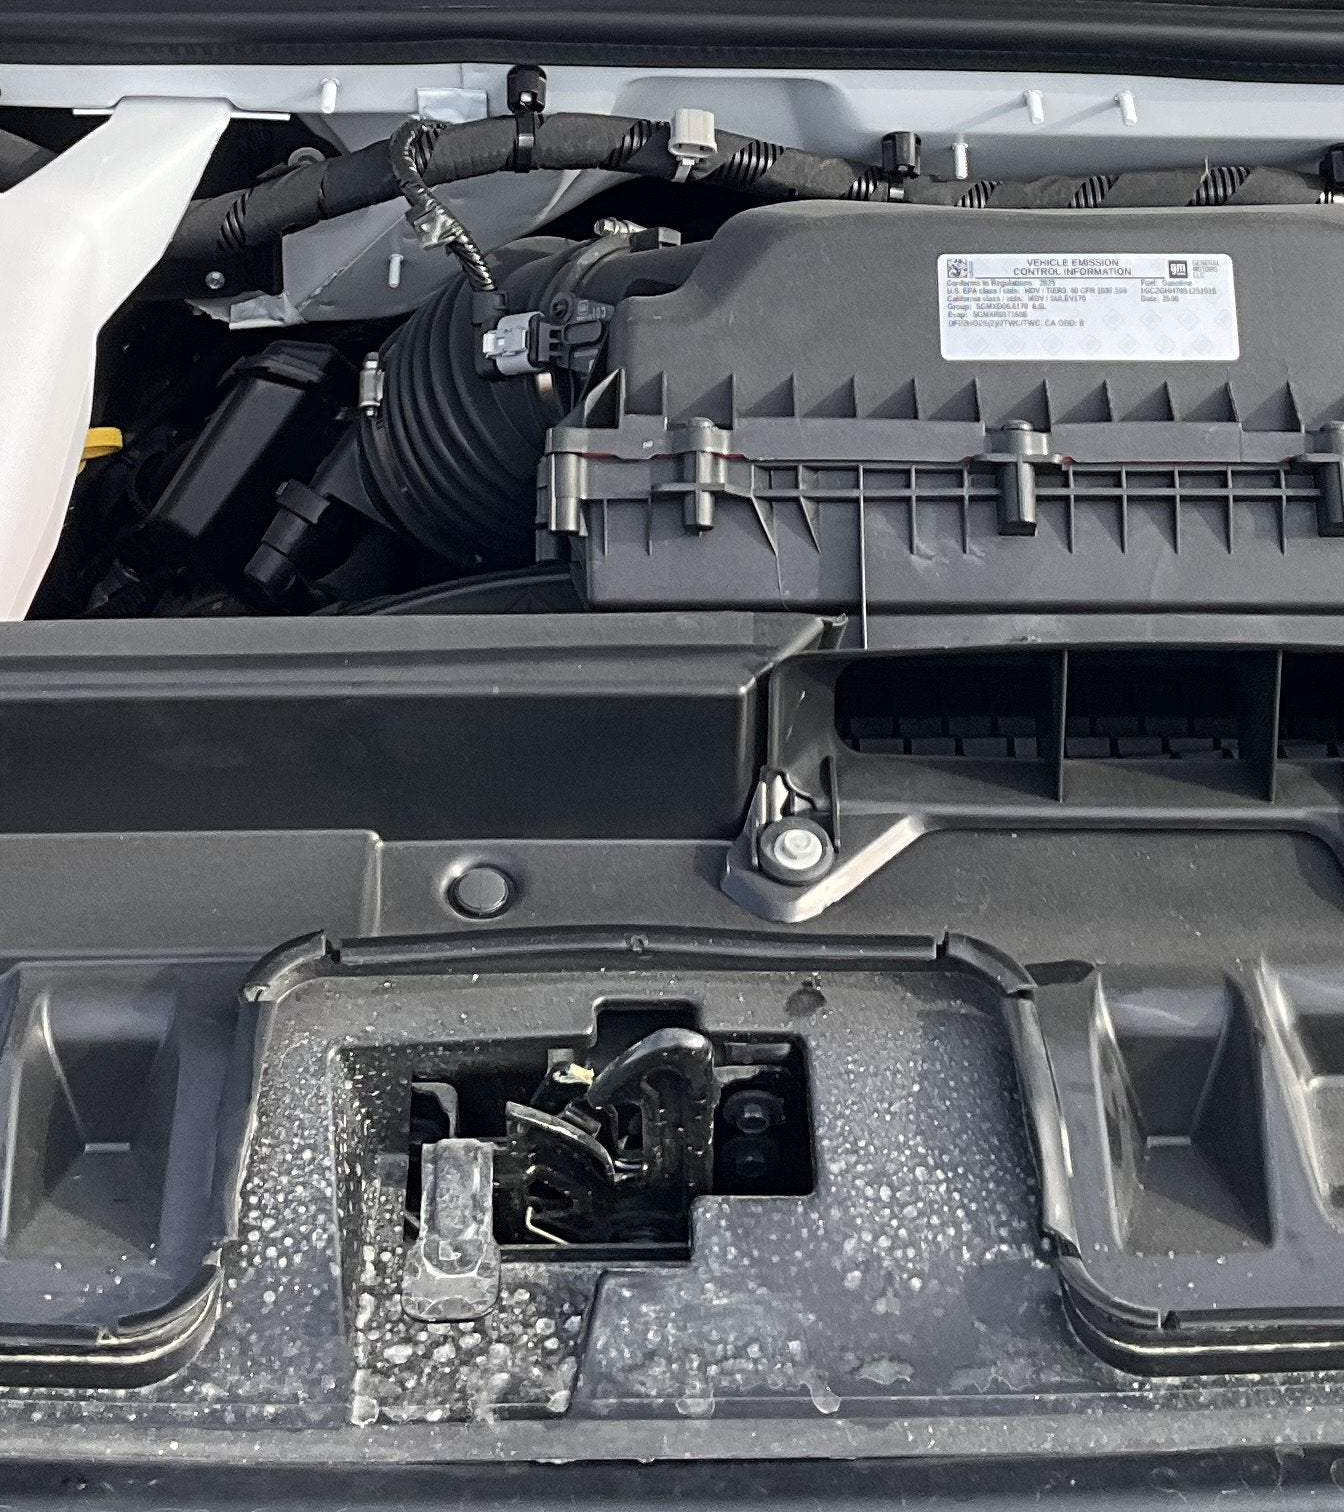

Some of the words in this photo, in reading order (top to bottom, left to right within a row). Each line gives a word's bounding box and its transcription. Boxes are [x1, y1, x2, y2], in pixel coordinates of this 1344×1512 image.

[1027, 258, 1069, 267] VEHICLE
[1071, 258, 1119, 267] EMISSION
[1013, 267, 1062, 276] CONTROL
[1064, 267, 1132, 276] INFORMATION
